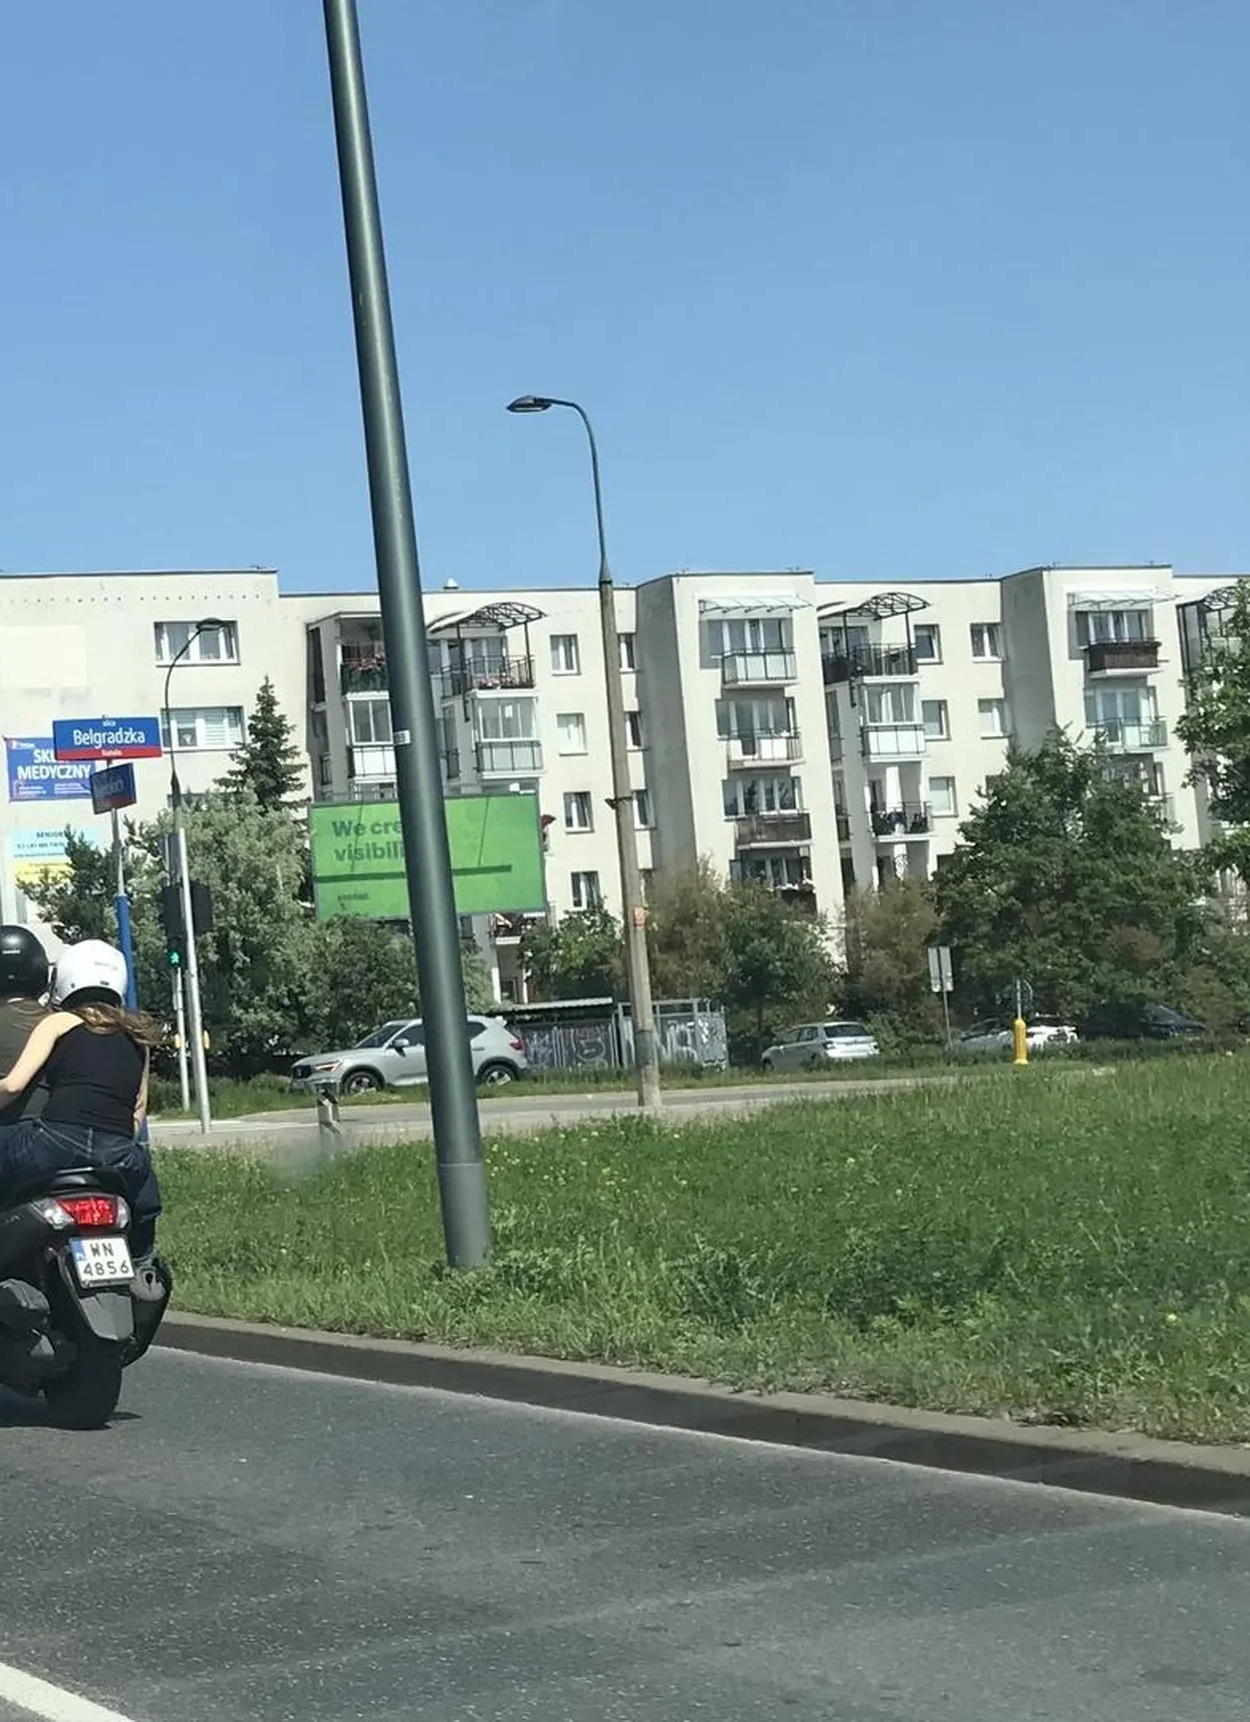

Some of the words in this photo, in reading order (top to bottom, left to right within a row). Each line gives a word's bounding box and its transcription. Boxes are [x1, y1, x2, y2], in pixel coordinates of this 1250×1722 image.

[73, 727, 146, 749] Belgradzka
[33, 749, 66, 764] SKL
[17, 764, 91, 780] MEDYCZNY
[332, 820, 367, 837] We
[370, 821, 402, 835] cre
[334, 841, 405, 862] visibili
[89, 1242, 115, 1258] WN
[83, 1260, 130, 1277] 4856
